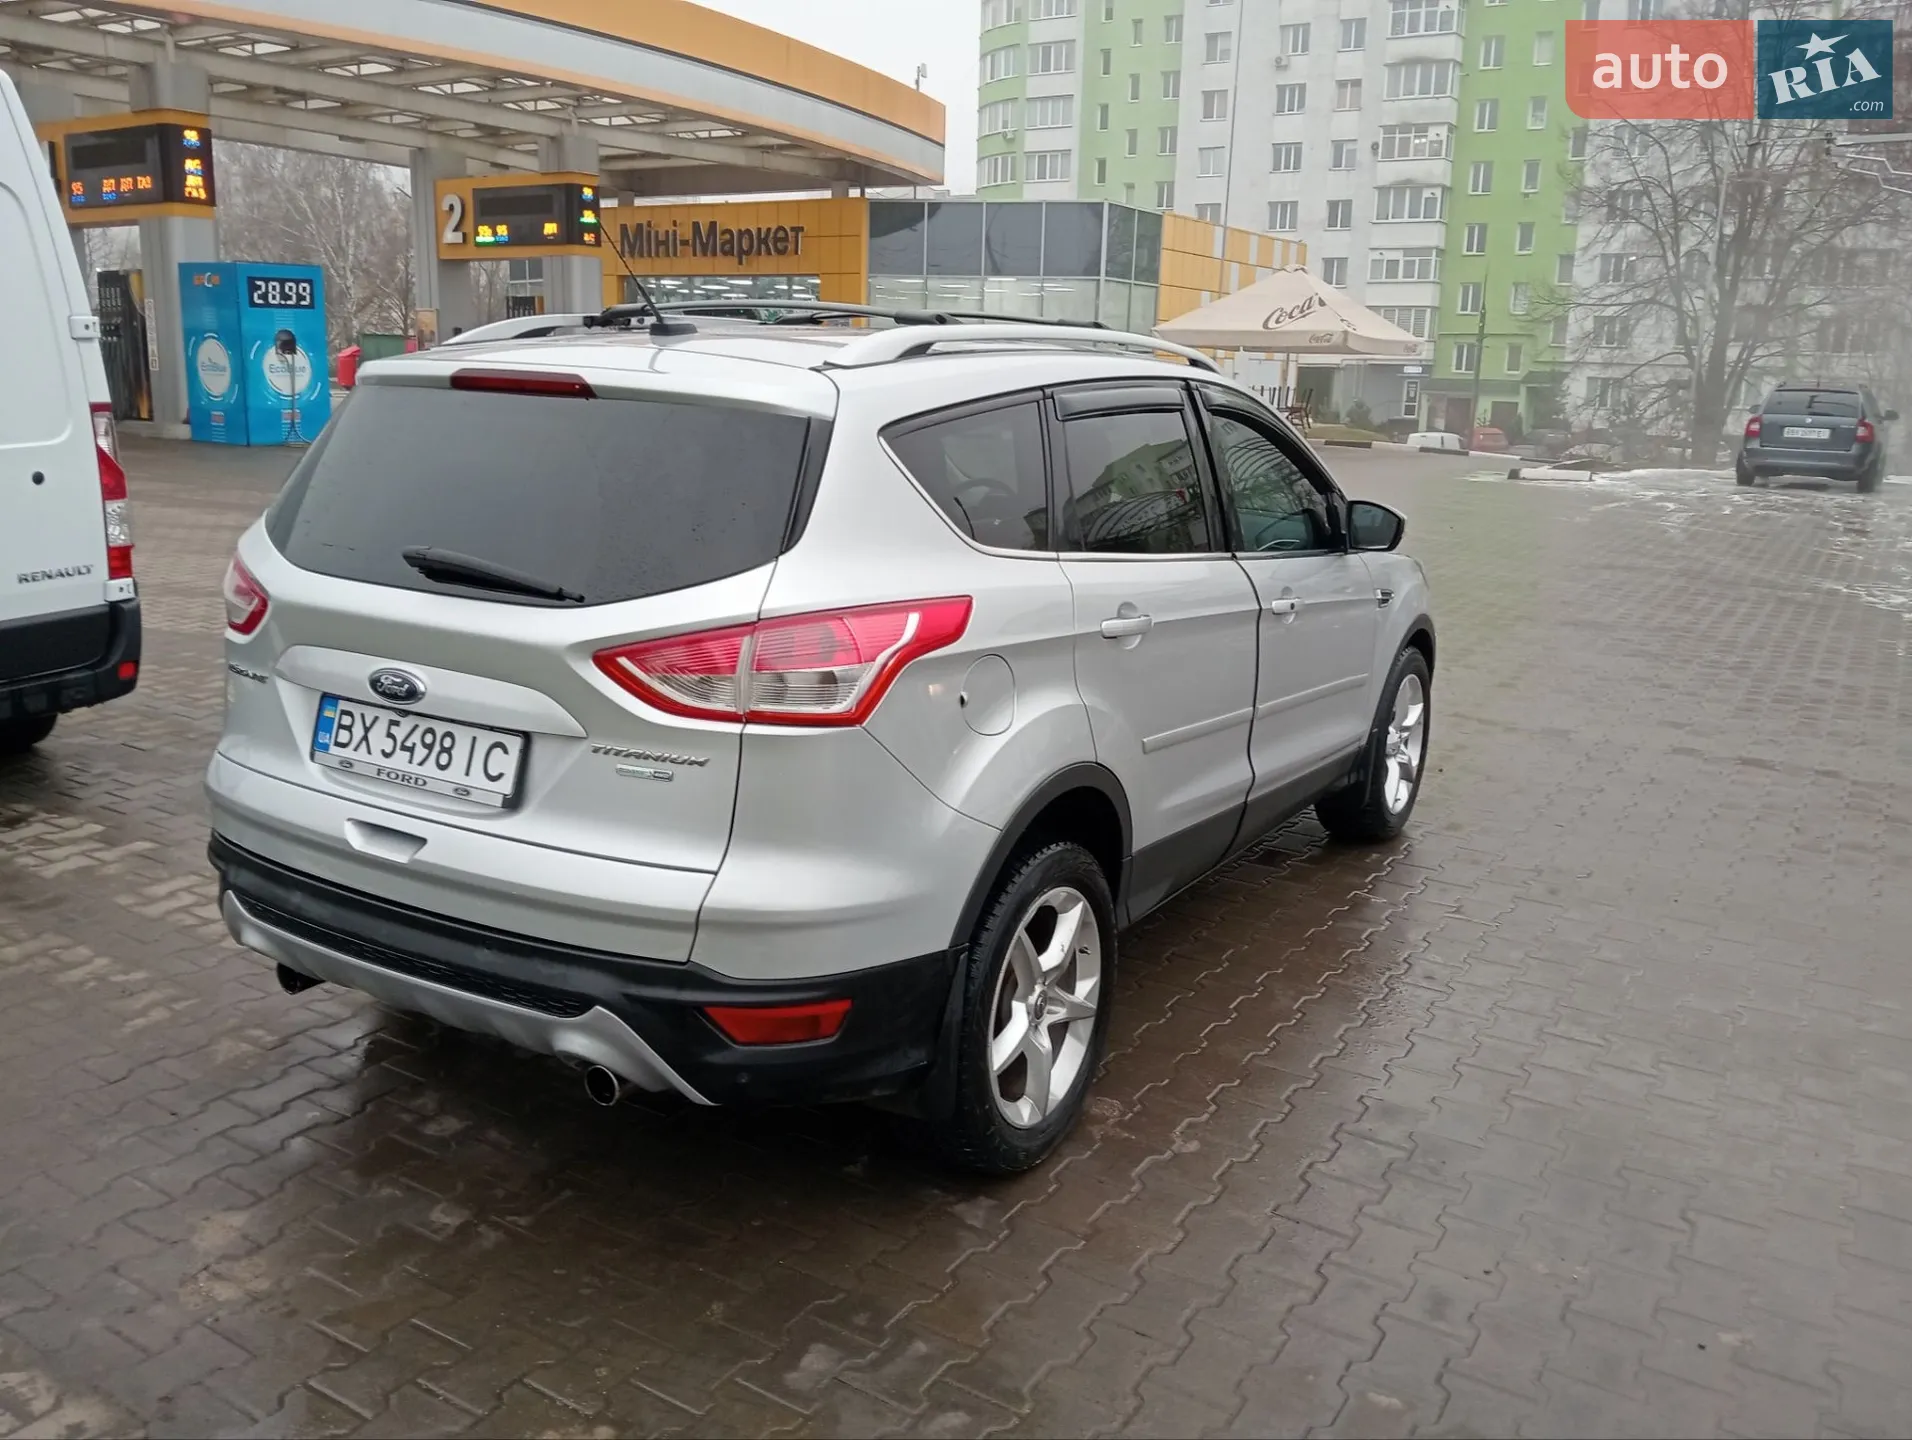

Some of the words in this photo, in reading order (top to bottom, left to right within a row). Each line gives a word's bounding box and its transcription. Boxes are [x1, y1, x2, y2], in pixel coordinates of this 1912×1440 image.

[442, 193, 464, 244] 2
[619, 219, 805, 266] Міні-Маркет
[253, 280, 311, 305] 28.99
[17, 564, 94, 584] RENAULT
[376, 674, 411, 698] Ford
[590, 743, 711, 767] TITANIUM
[376, 767, 428, 788] FORD
